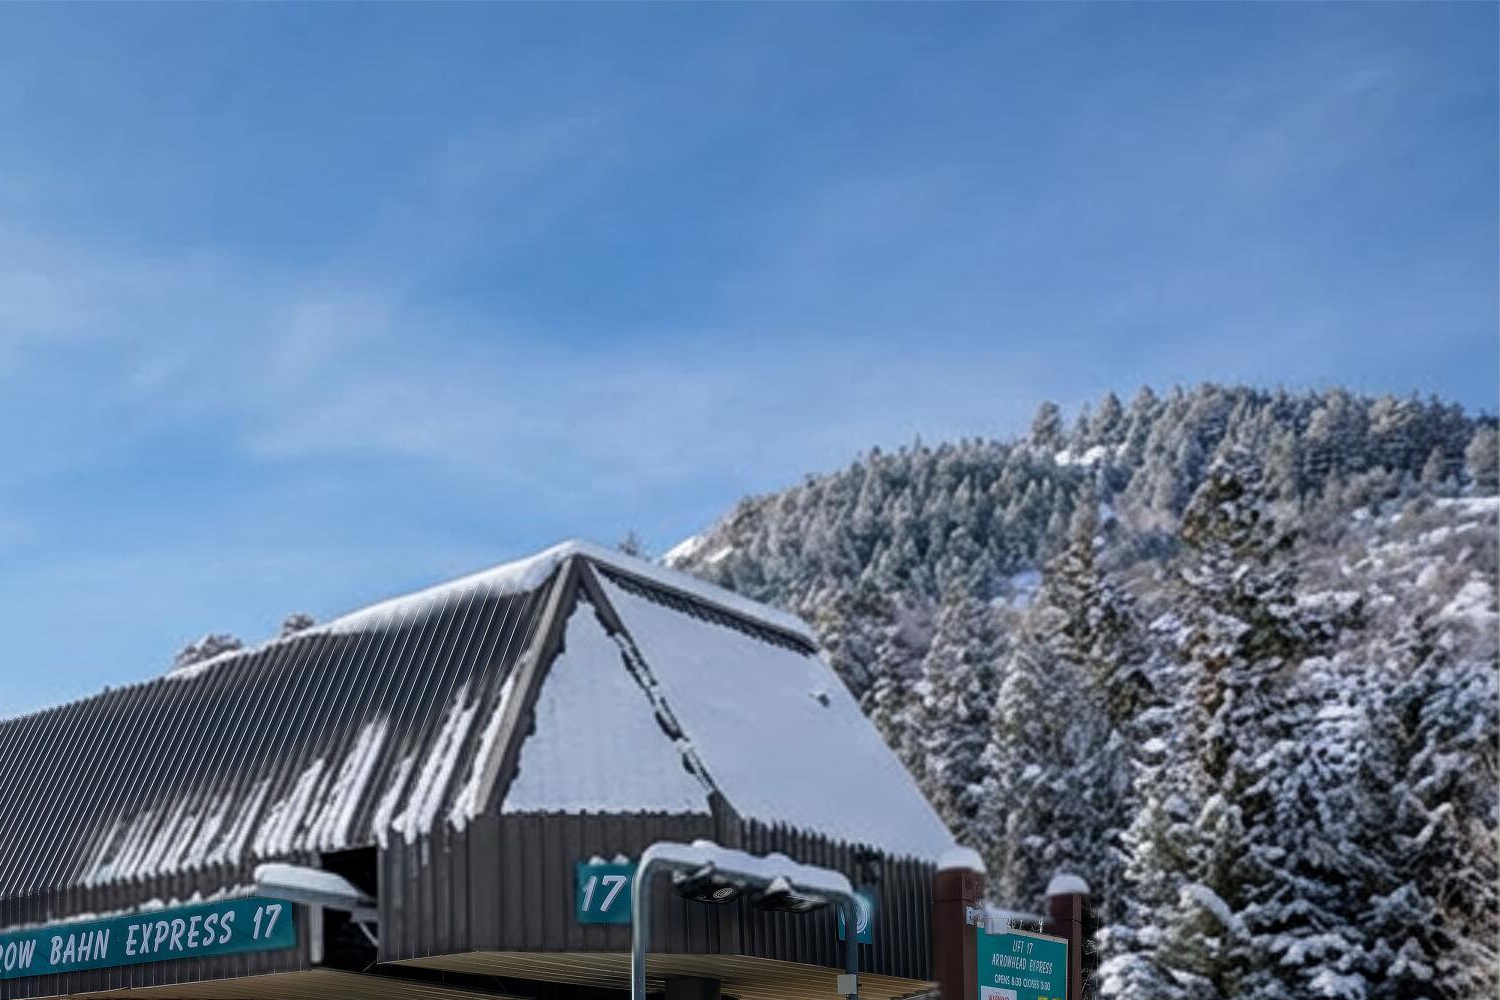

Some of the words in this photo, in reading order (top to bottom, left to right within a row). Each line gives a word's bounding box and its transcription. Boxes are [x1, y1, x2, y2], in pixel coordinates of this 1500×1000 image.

[581, 874, 628, 913] 17
[49, 928, 111, 966] BAHN
[125, 910, 236, 957] EXPRESS
[252, 903, 284, 941] 17
[1012, 939, 1025, 954] LIFT
[1026, 942, 1034, 955] 17
[991, 953, 1027, 971] ARROWHEAD
[994, 973, 1010, 985] OPENS
